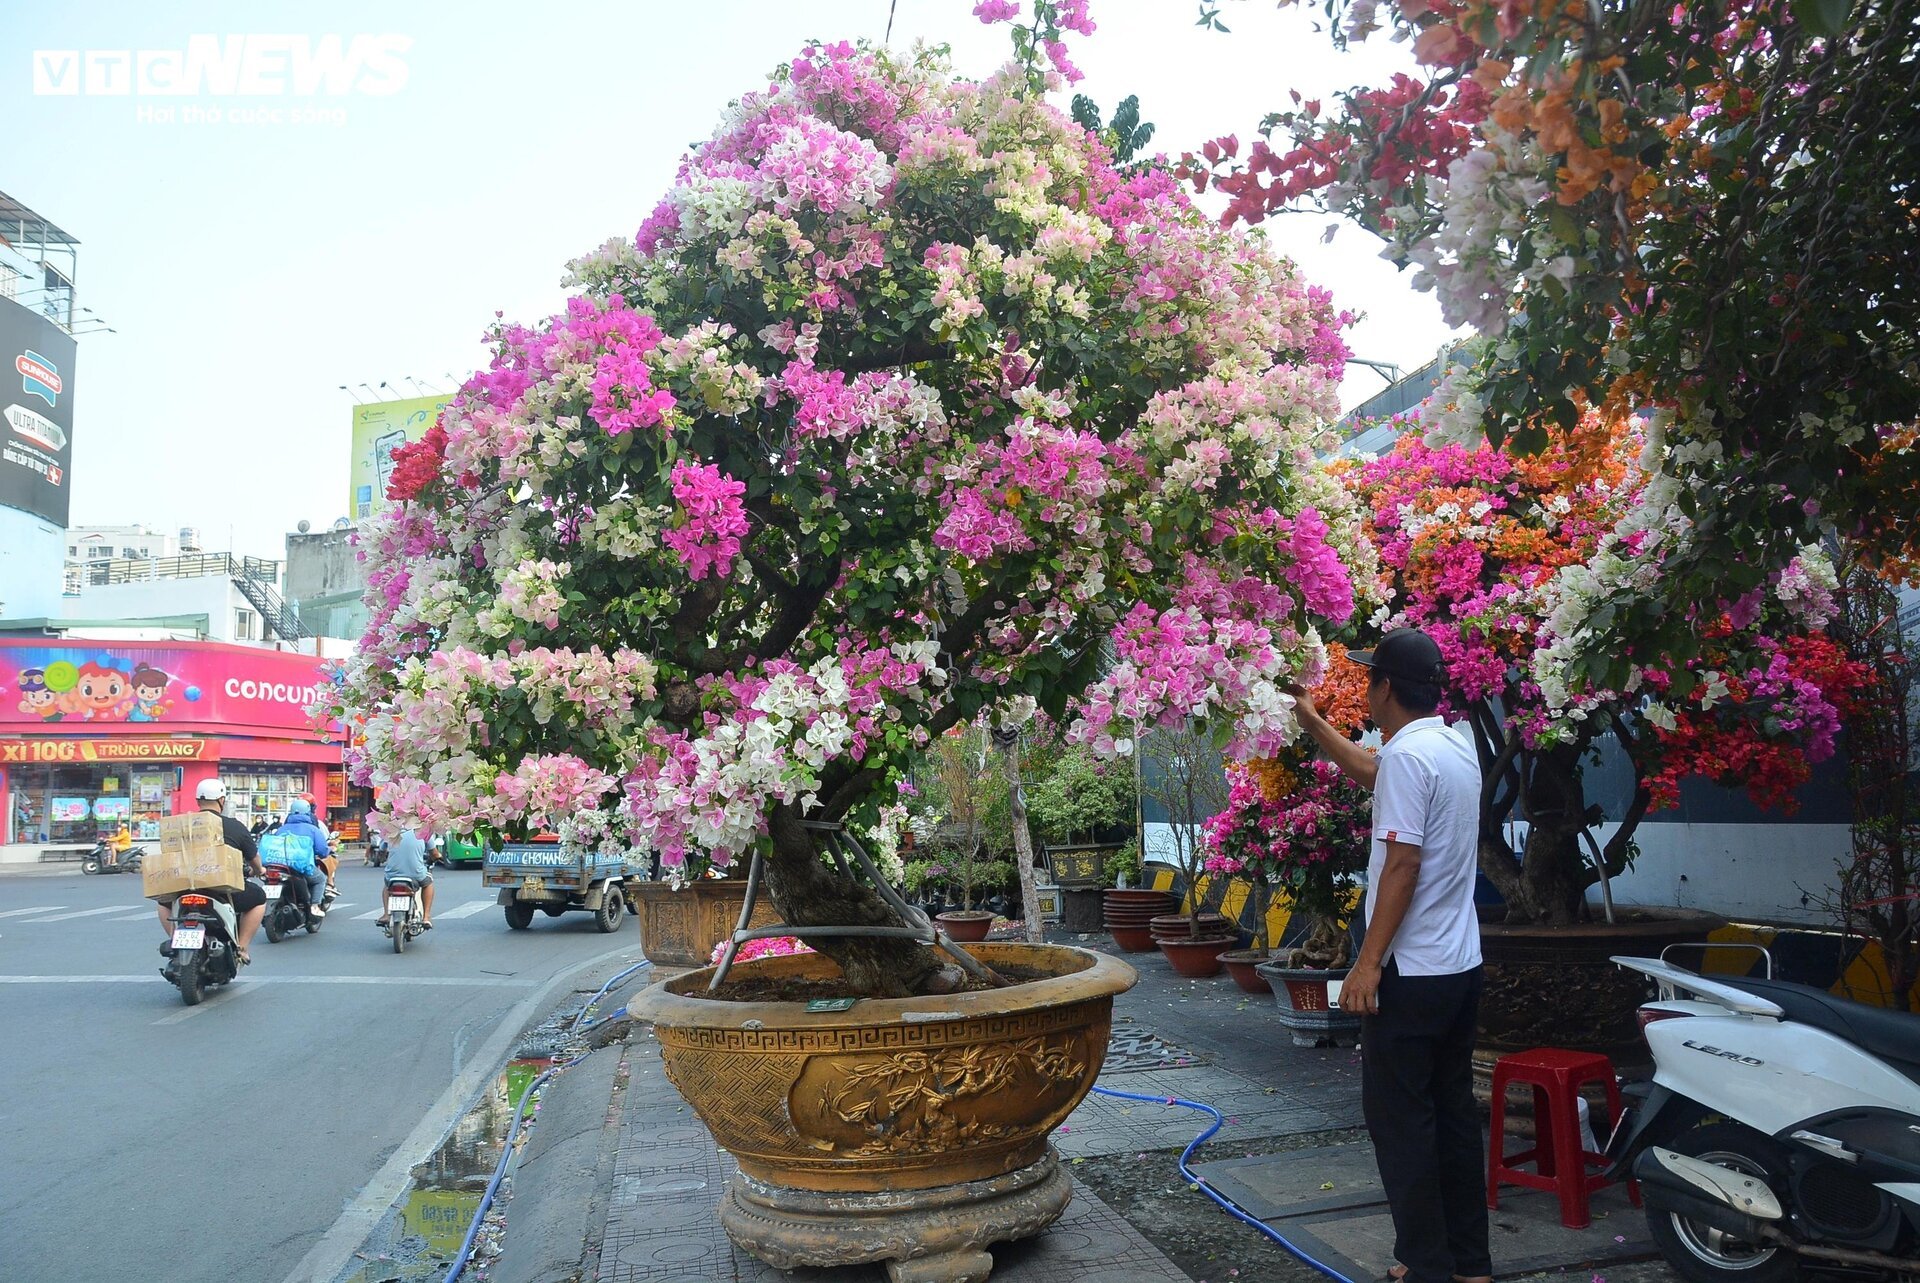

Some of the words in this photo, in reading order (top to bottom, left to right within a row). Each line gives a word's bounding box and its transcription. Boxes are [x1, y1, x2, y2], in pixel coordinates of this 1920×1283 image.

[13, 410, 36, 433] ULTRA
[153, 742, 194, 756] VÀNG
[1682, 1040, 1764, 1067] LEAD
